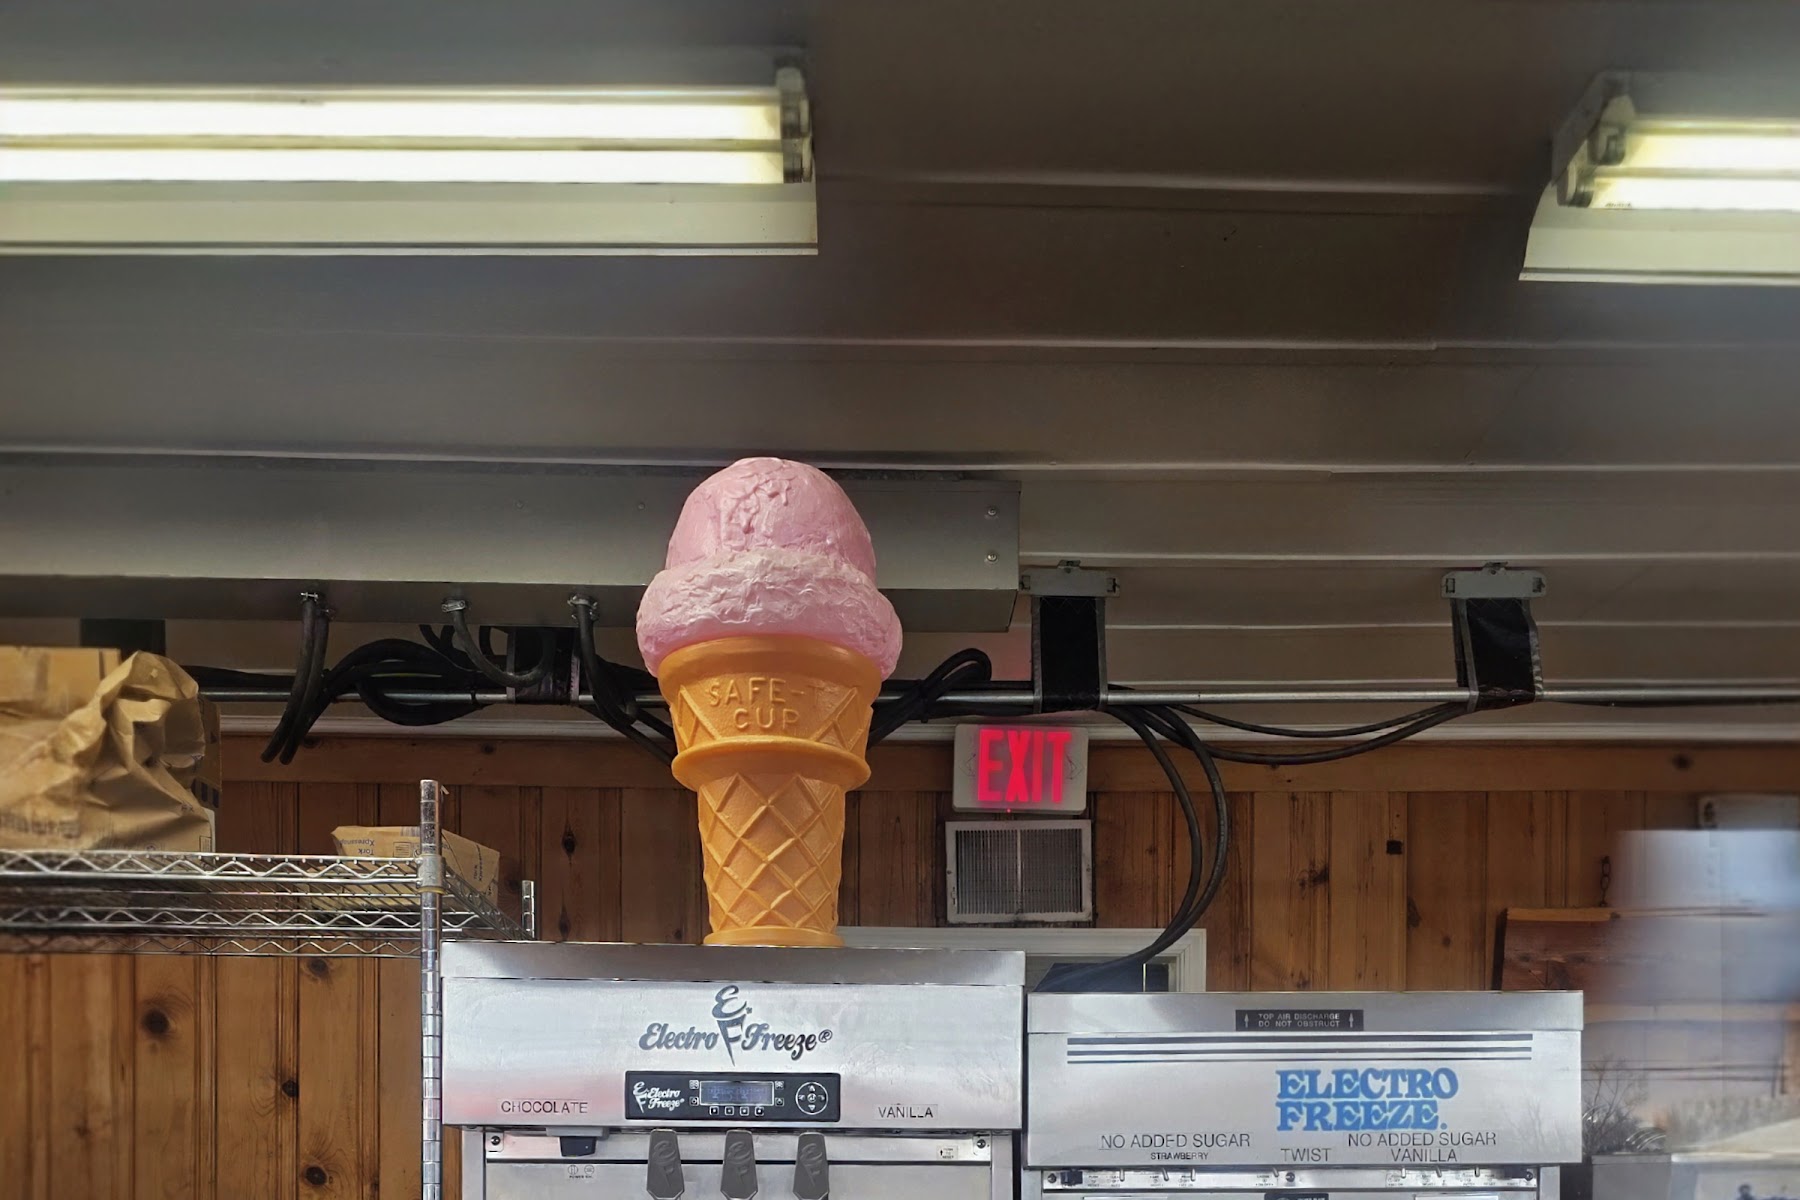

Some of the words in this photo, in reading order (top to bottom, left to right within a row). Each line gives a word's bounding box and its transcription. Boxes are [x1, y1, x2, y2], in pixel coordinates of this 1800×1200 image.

[733, 707, 800, 730] CUP
[977, 729, 1072, 803] EXIT
[638, 1022, 719, 1051] Electro
[1275, 1067, 1459, 1100] ELECTRO
[647, 1087, 681, 1099] Electro
[501, 1100, 588, 1113] CHOCOLATE
[1101, 1134, 1125, 1149] NO
[1130, 1133, 1187, 1149] ADDED
[1192, 1133, 1250, 1148] SUGAR
[1348, 1133, 1372, 1147] NO
[1377, 1132, 1434, 1146] ADDED
[1438, 1132, 1496, 1146] SUGAR
[1150, 1152, 1209, 1160] STRAWBERRY
[1280, 1148, 1332, 1162] TWIST
[1391, 1148, 1457, 1162] VANILLA
